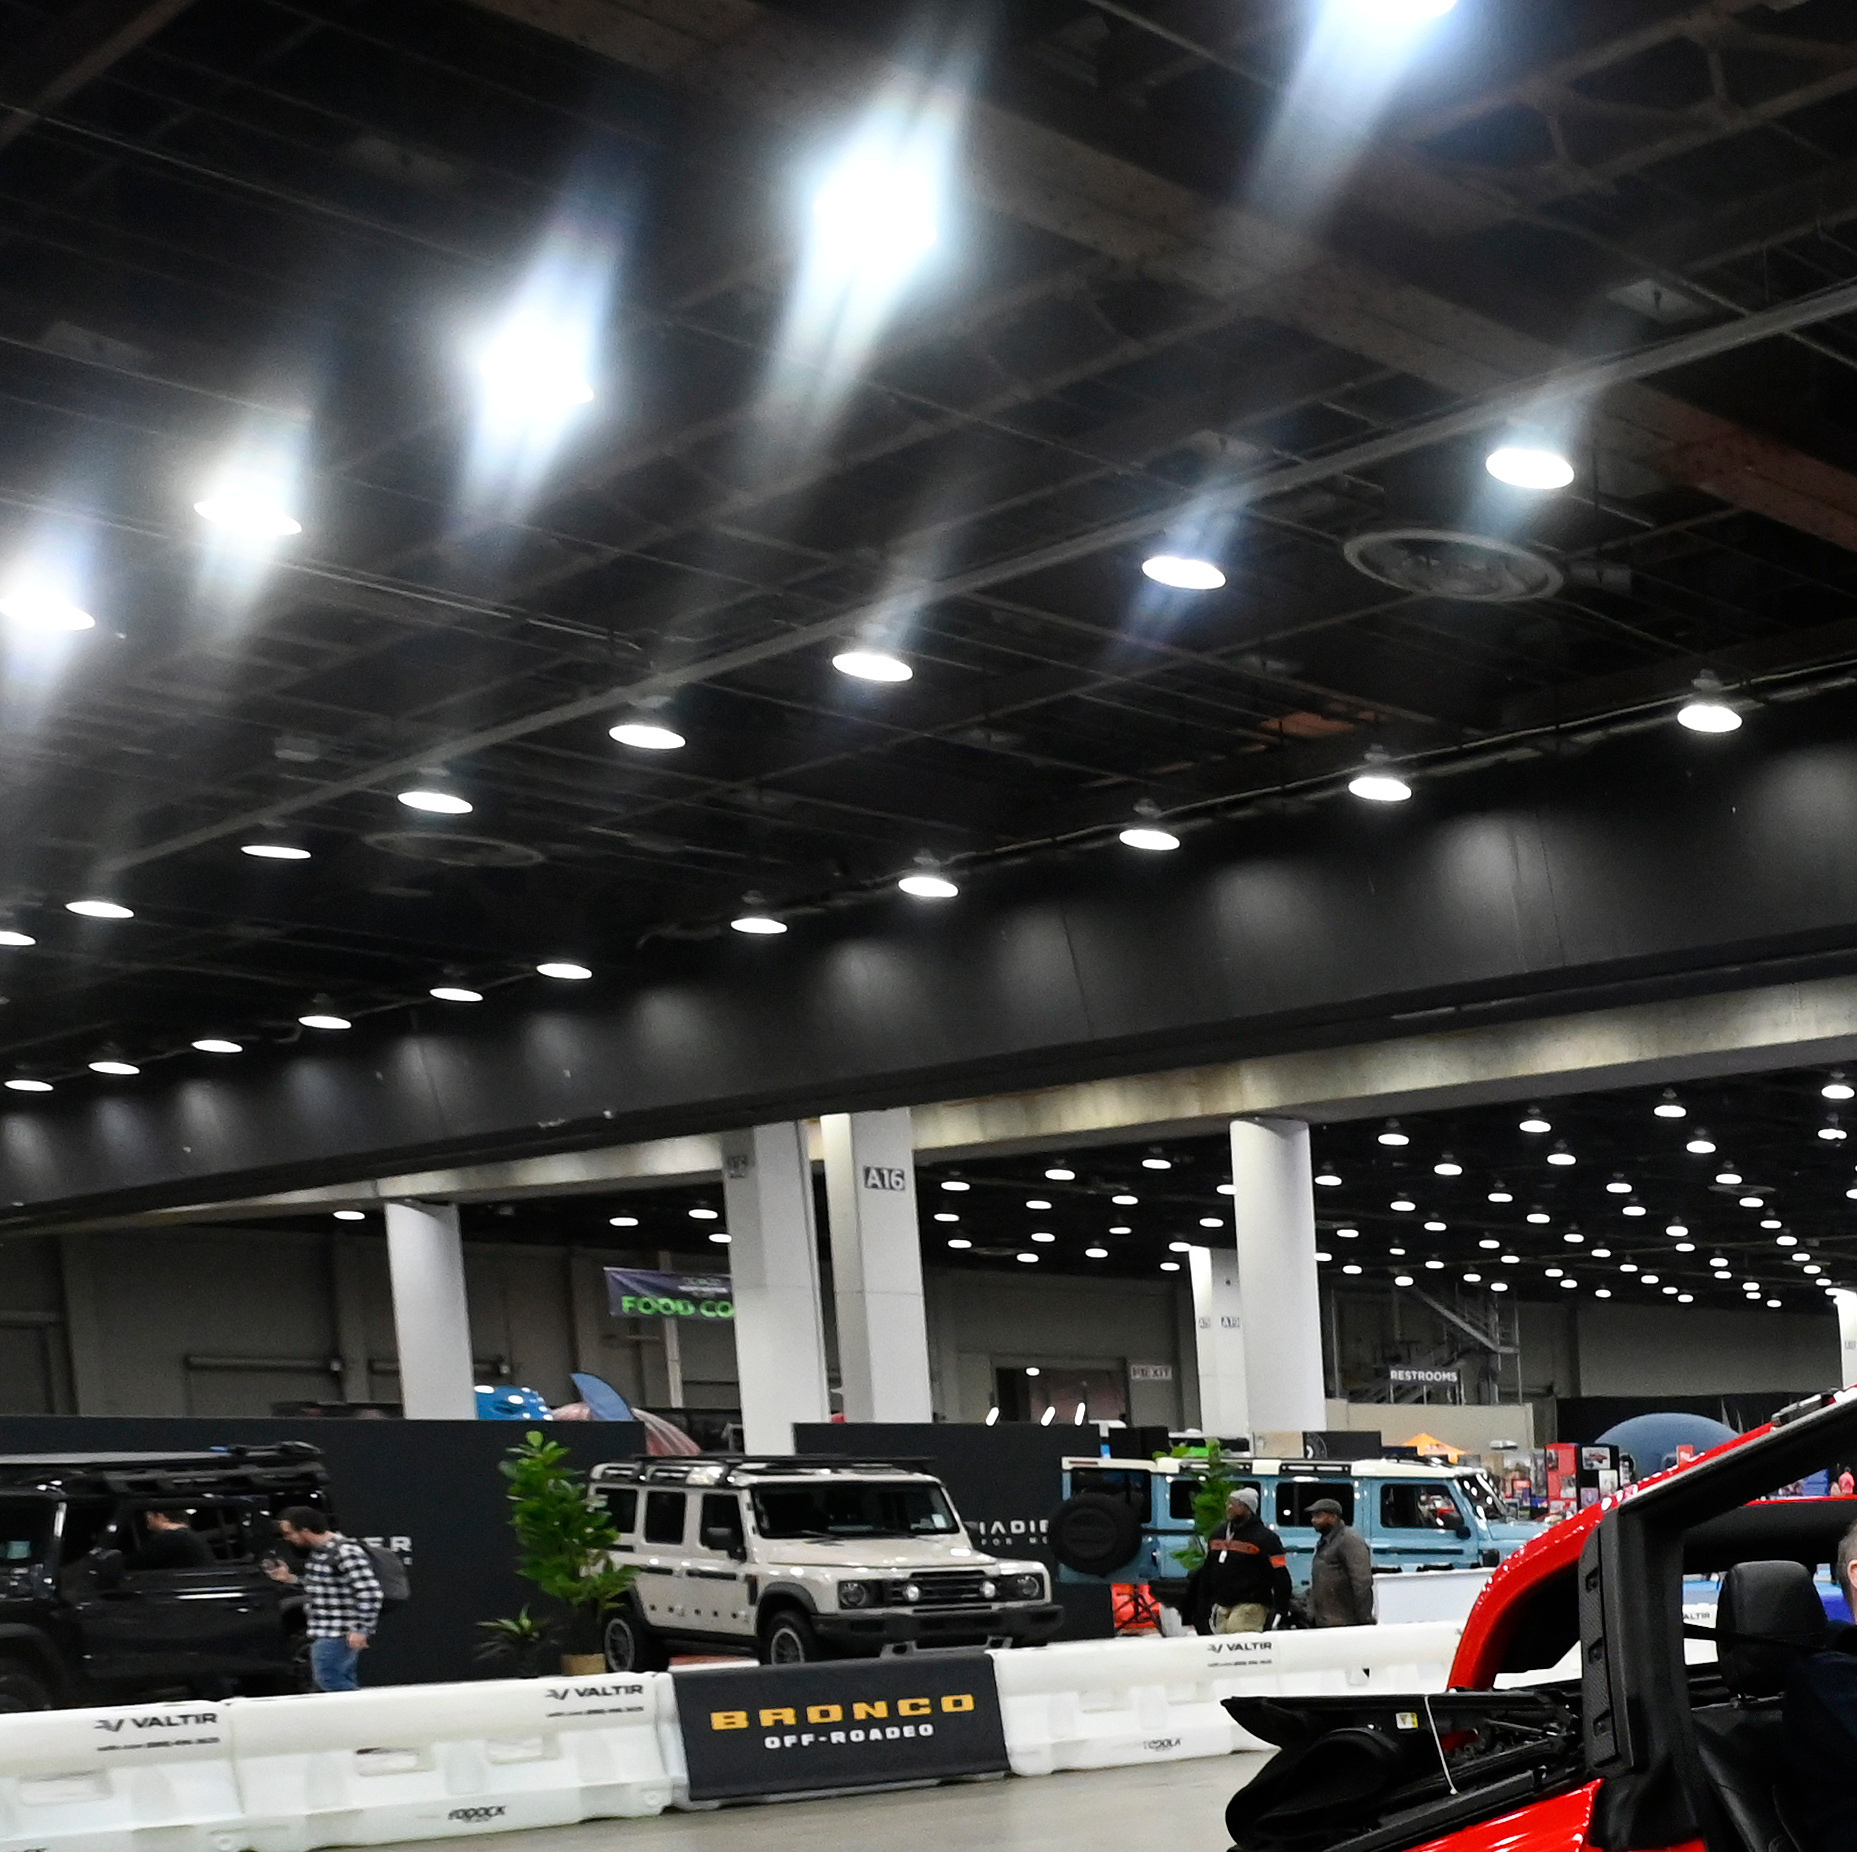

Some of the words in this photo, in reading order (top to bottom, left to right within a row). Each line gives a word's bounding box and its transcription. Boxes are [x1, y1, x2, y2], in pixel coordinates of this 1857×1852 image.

[866, 1167, 905, 1190] A16
[621, 1296, 696, 1316] FOOD
[1390, 1369, 1458, 1383] RESTROOMS
[1225, 1641, 1273, 1652] VALTIR
[574, 1684, 643, 1698] VALTIR
[130, 1712, 218, 1729] VALTIR
[710, 1693, 975, 1731] BRONCO
[763, 1723, 934, 1750] OFF-ROADEO
